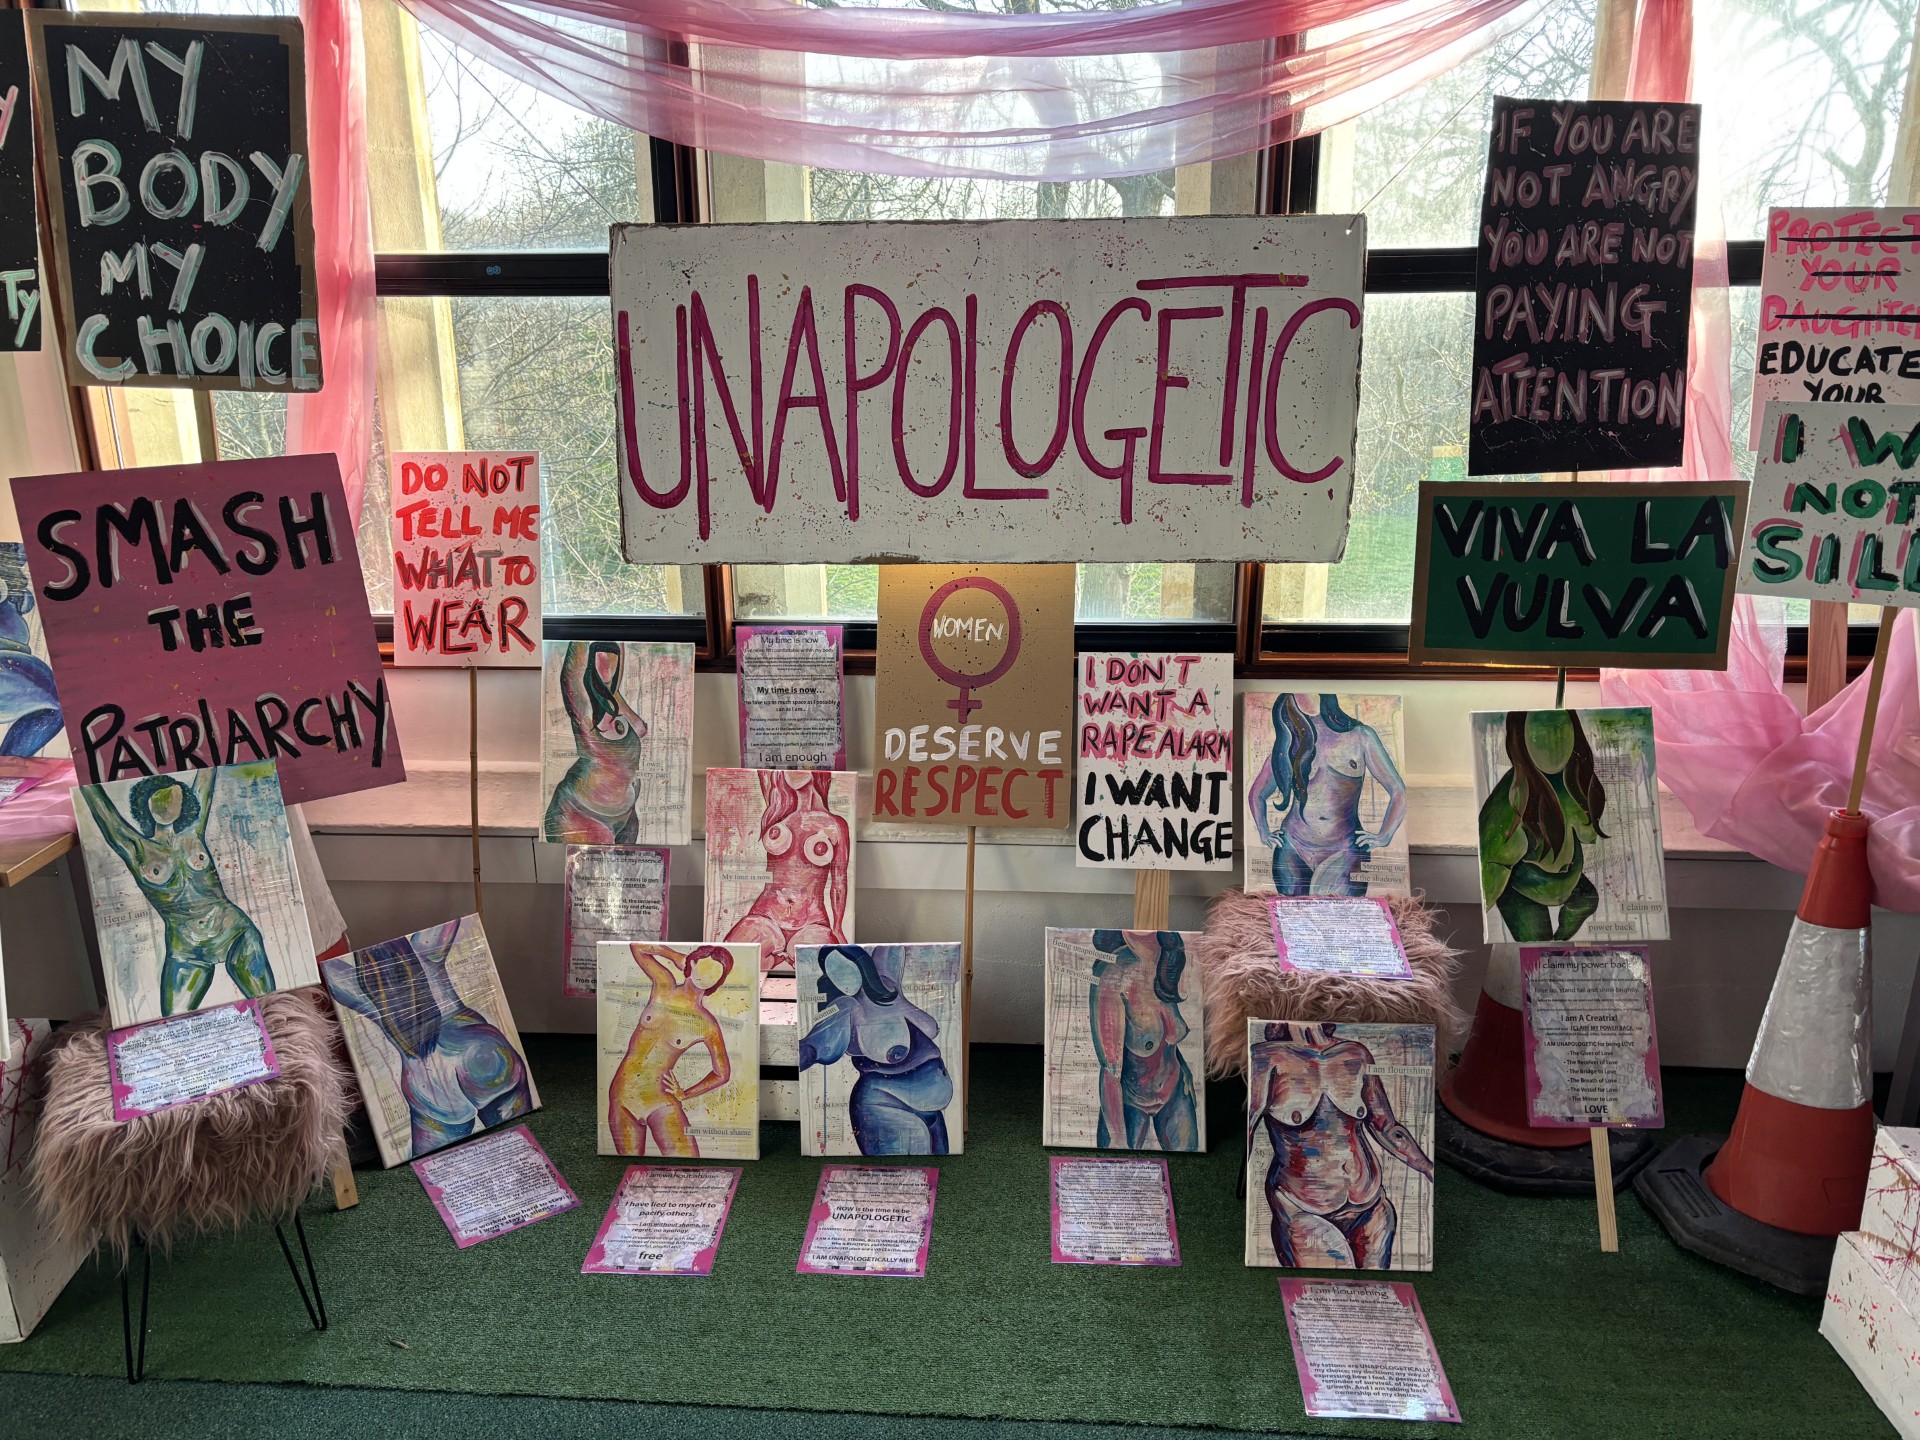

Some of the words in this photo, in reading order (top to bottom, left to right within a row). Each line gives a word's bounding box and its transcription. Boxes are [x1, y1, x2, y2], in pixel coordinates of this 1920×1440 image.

[65, 38, 204, 140] MY
[1499, 108, 1533, 155] IF
[1551, 107, 1614, 154] YOU
[1621, 106, 1699, 155] ARE
[72, 140, 302, 253] BODY
[1490, 163, 1572, 208] NOT
[1583, 162, 1699, 225] ANGRY
[1485, 224, 1548, 273] YOU
[1556, 222, 1620, 266] ARE
[1631, 227, 1696, 270] NOT
[1769, 210, 1920, 256] PROTECT
[100, 241, 205, 313] MY
[1799, 255, 1902, 294] YOUR
[1485, 283, 1666, 348] PAYING
[1761, 295, 1920, 340] DAUGHTE
[76, 313, 323, 391] CHOICE
[1759, 341, 1920, 380] EDUCATE
[618, 274, 1361, 541] UNAPOLOGETIC
[1472, 352, 1684, 428] ATTENTION
[1803, 378, 1886, 404] YOUR
[1773, 413, 1805, 464] I
[402, 462, 448, 496] DO
[462, 457, 535, 497] NOT
[395, 500, 482, 541] TELL
[493, 504, 540, 541] ME
[1783, 478, 1920, 526] NOT
[37, 491, 342, 600] SMASH
[1436, 500, 1596, 566] VIVA
[1631, 497, 1736, 569] LA
[395, 545, 505, 592] WHAT
[501, 556, 537, 586] TO
[148, 592, 263, 653] THE
[403, 596, 537, 655] WEAR
[1456, 574, 1709, 640] VULVA
[760, 636, 774, 647] My
[775, 636, 792, 644] time
[794, 636, 801, 644] is
[932, 616, 1004, 643] WOMEN
[756, 686, 769, 695] My
[771, 686, 787, 694] time
[791, 686, 798, 694] is
[1085, 656, 1097, 688] I
[1106, 655, 1201, 686] DON'T
[1081, 689, 1181, 718] WANT
[1188, 688, 1211, 717] A
[79, 679, 389, 785] PATRIARCHY
[883, 724, 1063, 765] DESERVE
[1080, 722, 1151, 760] RAPE
[1163, 726, 1232, 768] ALARM
[765, 754, 782, 762] am
[785, 752, 827, 764] enough
[874, 765, 1065, 819] RESPECT
[1084, 772, 1097, 805] I
[1105, 770, 1228, 816] WANT
[1078, 814, 1233, 863] CHANGE
[1359, 874, 1371, 882] the
[1362, 862, 1393, 872] Stepping
[104, 915, 125, 924] Here
[134, 911, 150, 919] am
[1627, 903, 1648, 911] claim
[1650, 904, 1664, 912] my
[1588, 923, 1612, 933] power
[1614, 923, 1634, 931] back
[1052, 939, 1071, 950] Being
[1073, 945, 1115, 961] unapologetic
[1542, 959, 1565, 969] claim
[1566, 962, 1579, 973] my
[1581, 962, 1609, 973] power
[1066, 969, 1099, 984] revolution
[800, 995, 825, 1003] Unique
[813, 1007, 837, 1020] woman
[1578, 1014, 1584, 1022] A
[1585, 1014, 1618, 1022] Creatrix!
[1387, 1065, 1431, 1076] flourishing
[1584, 1104, 1609, 1114] LOVE
[702, 1128, 728, 1136] without
[678, 1201, 706, 1210] myself
[832, 1213, 912, 1222] UNAPOLOGETIC
[639, 1251, 664, 1260] free
[828, 1255, 898, 1263] UNAPOLOGETICALLY
[1332, 1286, 1390, 1300] flourishing
